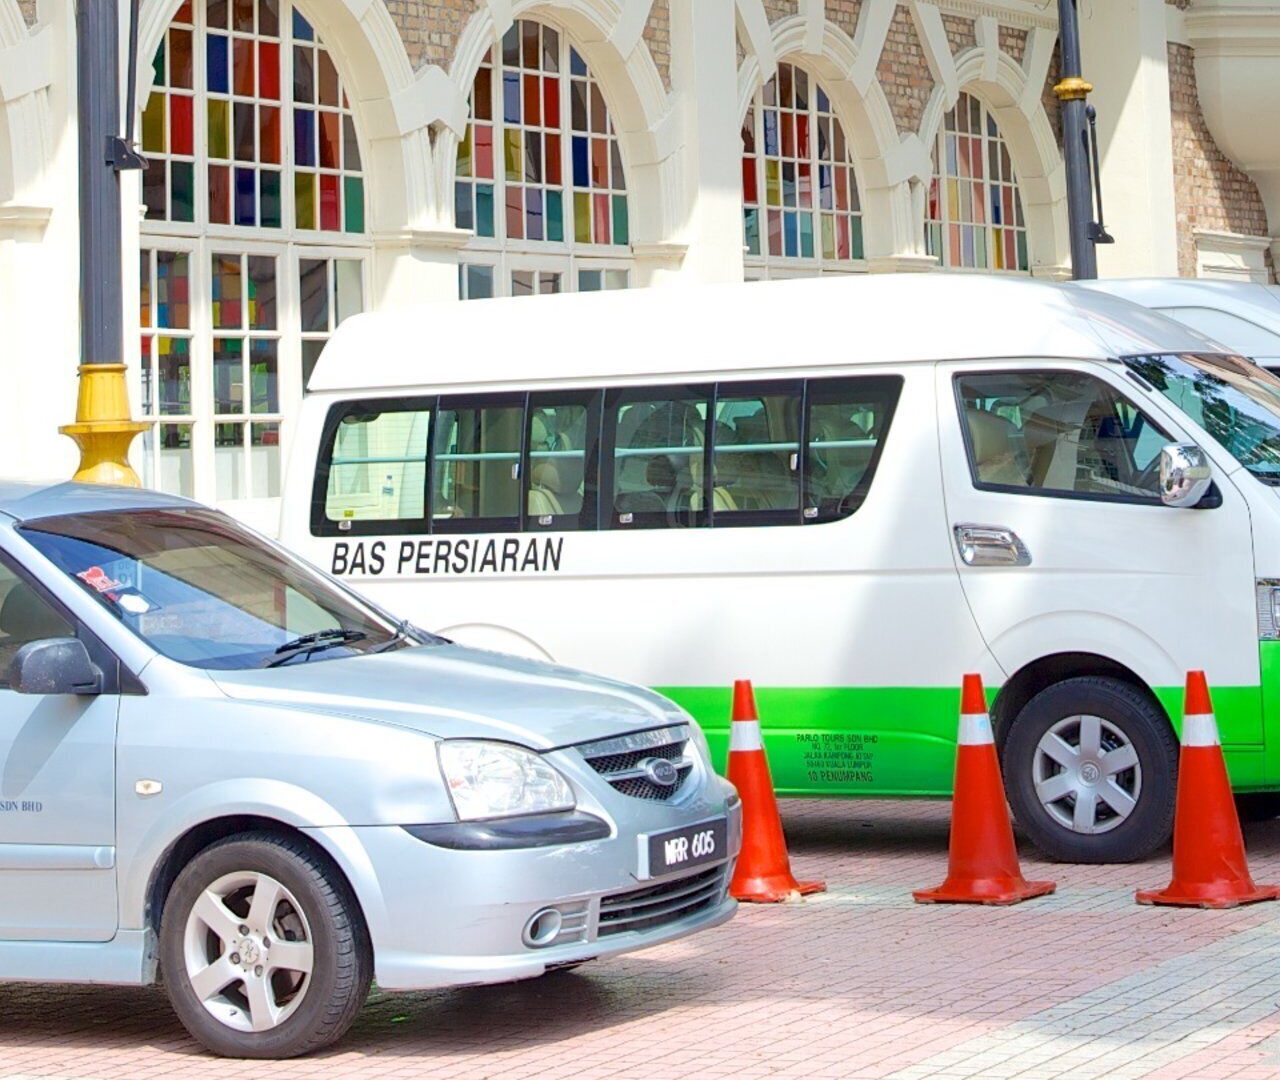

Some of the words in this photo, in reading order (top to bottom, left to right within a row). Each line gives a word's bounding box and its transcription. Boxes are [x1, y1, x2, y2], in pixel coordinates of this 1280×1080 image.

[331, 540, 387, 575] BAS
[396, 537, 564, 575] PERSIARAN
[821, 734, 844, 743] TOURS
[847, 734, 862, 743] SDN
[820, 771, 873, 782] PENUMPANG
[0, 801, 19, 811] SDN
[21, 801, 43, 812] BHD
[691, 830, 715, 858] 605
